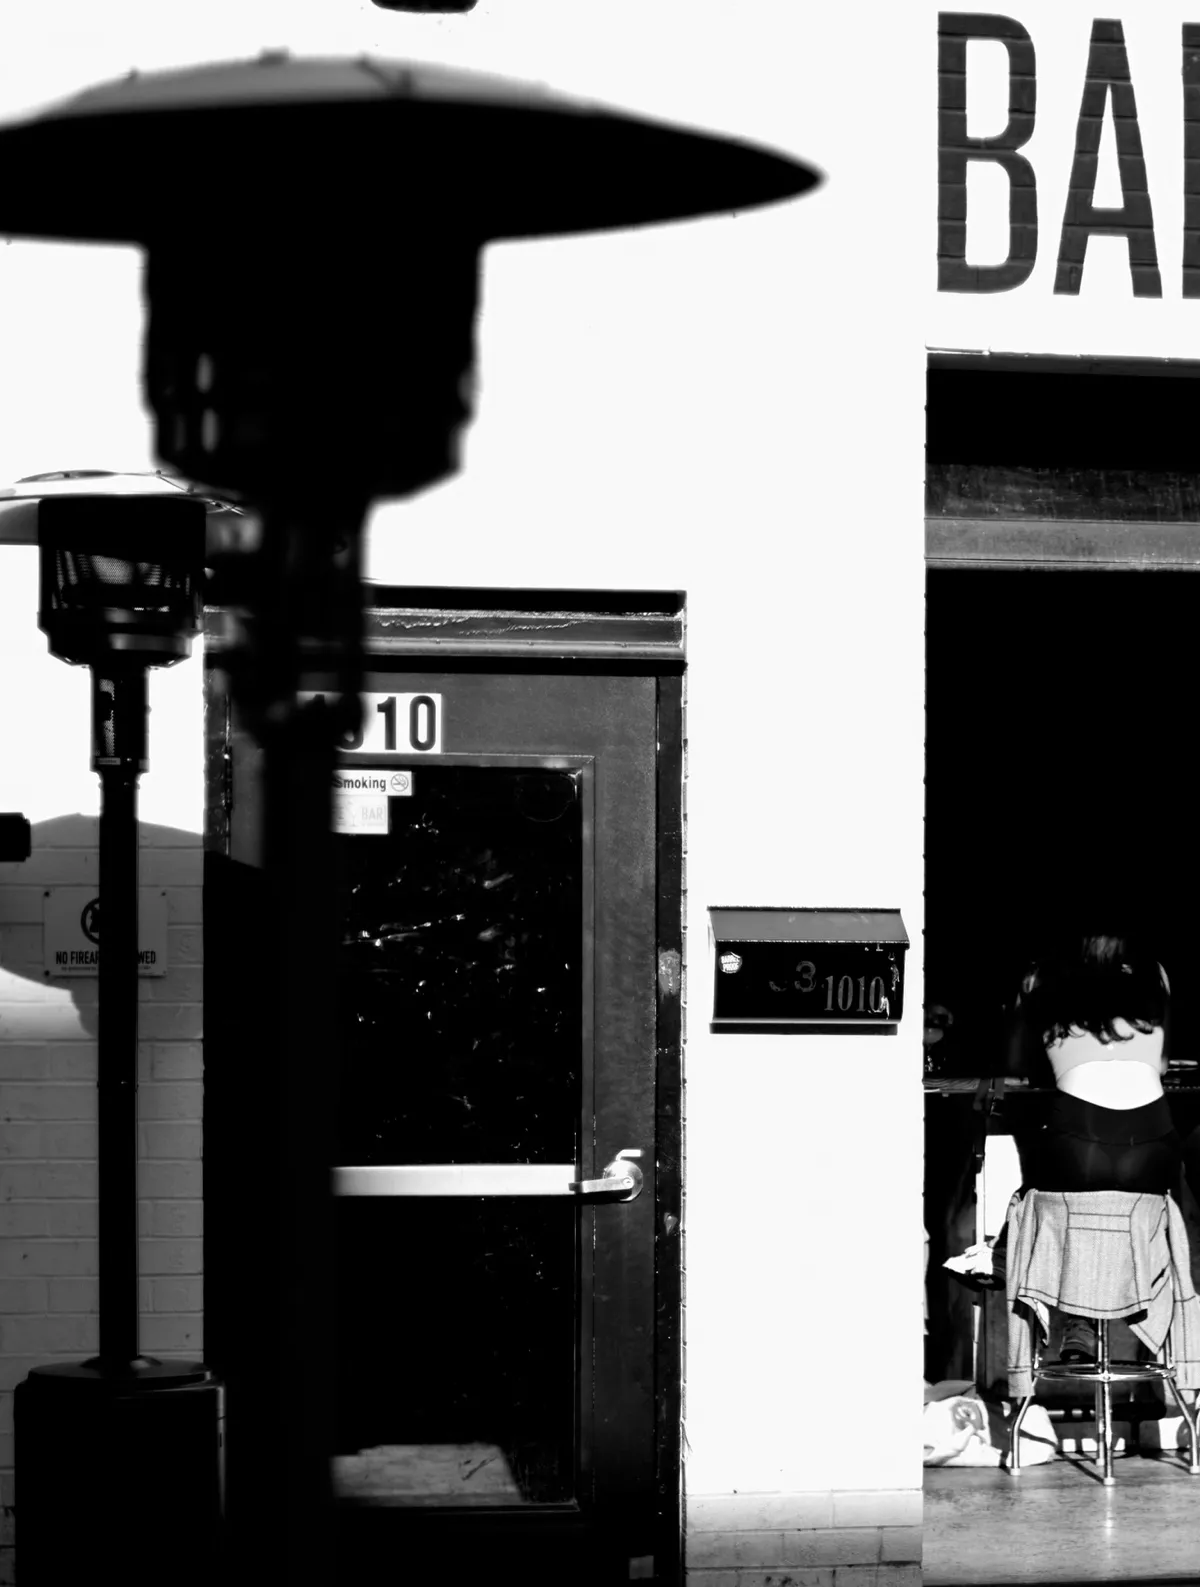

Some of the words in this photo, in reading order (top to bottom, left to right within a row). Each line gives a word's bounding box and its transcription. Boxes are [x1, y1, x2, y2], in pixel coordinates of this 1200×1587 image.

[361, 807, 383, 821] BAR
[55, 951, 68, 964] NO
[137, 951, 156, 964] WED
[824, 975, 886, 1012] 1010
